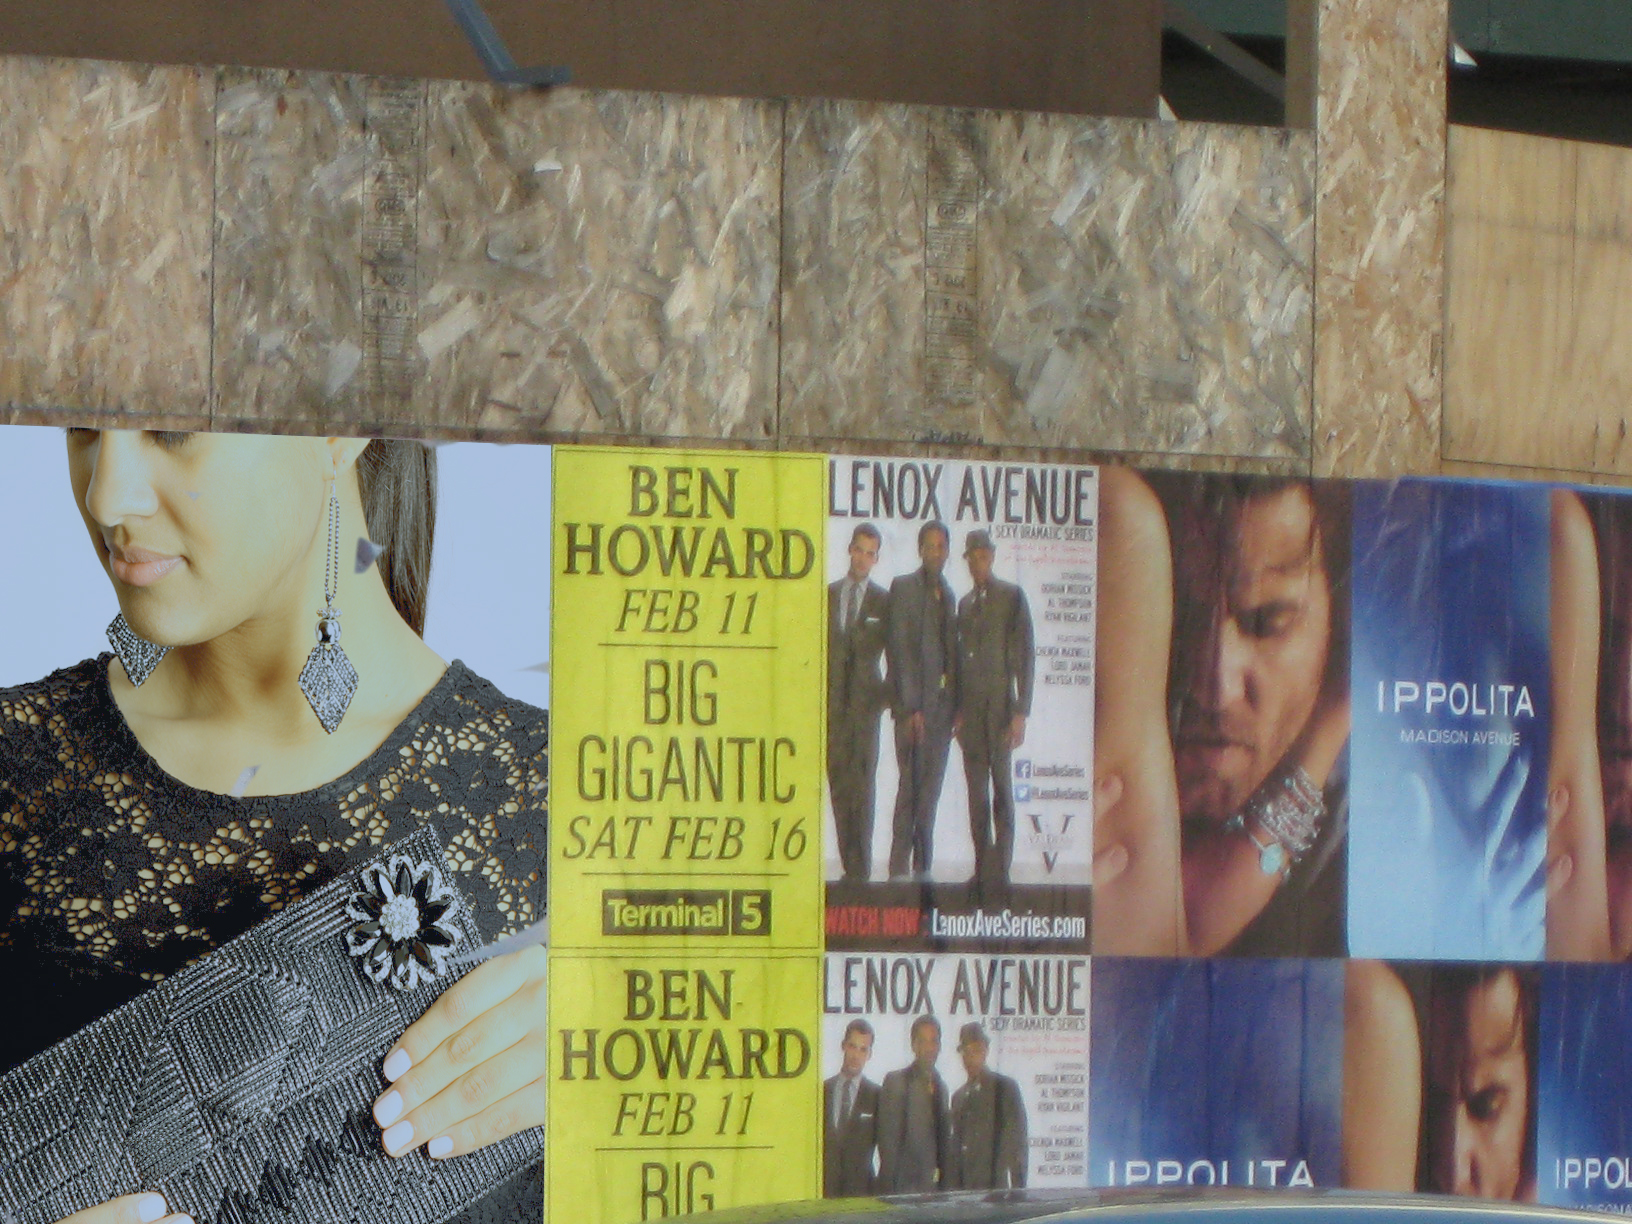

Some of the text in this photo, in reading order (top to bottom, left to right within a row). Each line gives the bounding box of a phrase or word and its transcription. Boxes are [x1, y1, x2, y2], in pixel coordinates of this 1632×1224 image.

[628, 465, 738, 518] BEN
[829, 460, 1094, 526] LENOX AVENUE
[562, 524, 816, 580] HOWARD
[1065, 527, 1094, 542] SERIES
[615, 589, 760, 635] FEB 11
[643, 659, 718, 726] BIG
[1377, 680, 1536, 718] IPPOLITA
[1400, 729, 1521, 747] MADISON AVENUE
[577, 735, 797, 803] GIGANTIC
[562, 815, 807, 862] SAT FEB 16
[607, 895, 763, 931] Terminal 5
[932, 907, 1086, 939] LenoxAveSeries.com
[624, 969, 735, 1021] BEN
[823, 957, 1086, 1016] LENOX AVENUE
[559, 1028, 812, 1081] HOWARD
[612, 1092, 755, 1136] FEB 11
[641, 1161, 715, 1222] BIG
